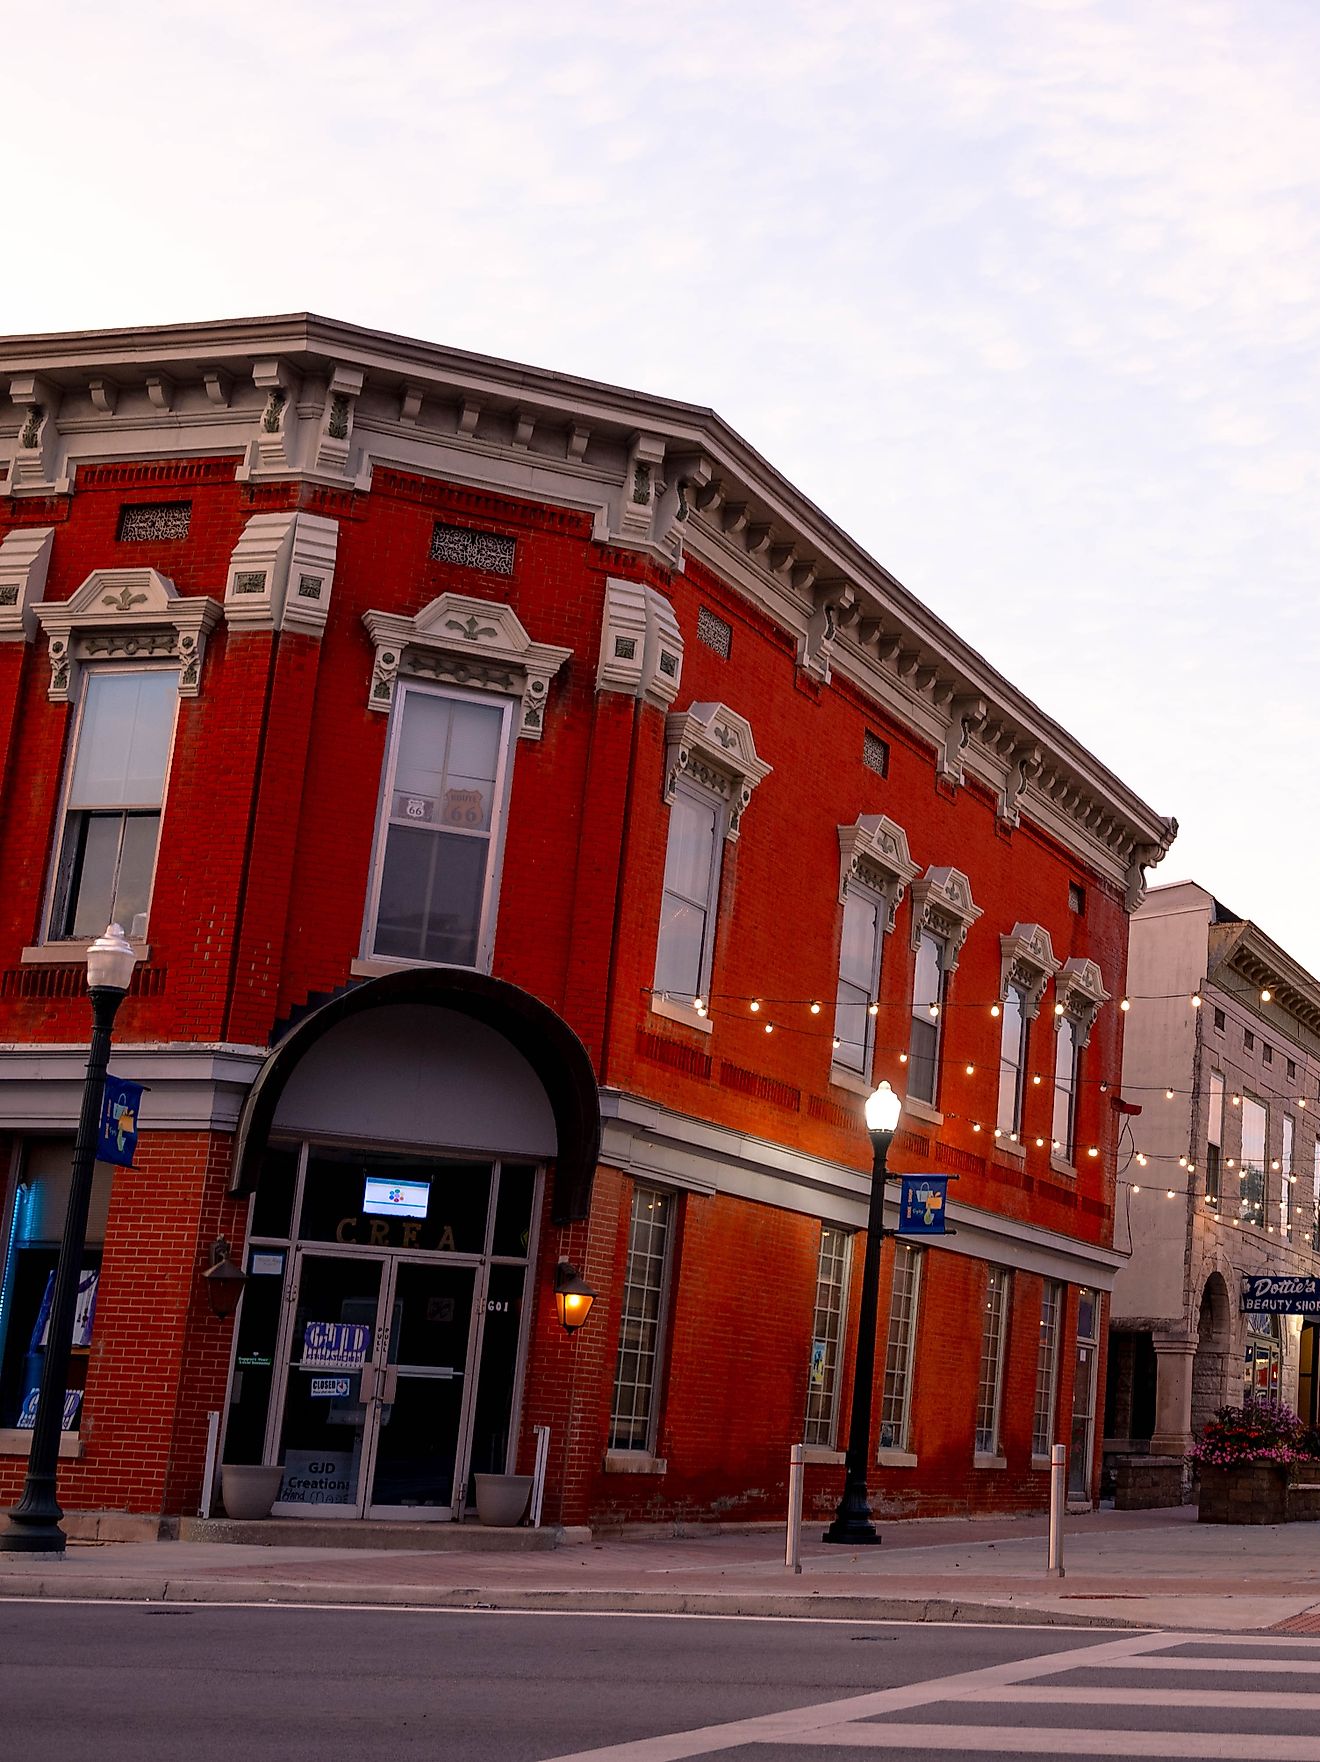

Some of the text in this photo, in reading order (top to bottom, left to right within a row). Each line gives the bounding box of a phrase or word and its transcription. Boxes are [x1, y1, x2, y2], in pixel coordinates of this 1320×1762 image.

[409, 806, 422, 815] 66
[452, 807, 477, 823] 66
[1254, 1278, 1316, 1297] Dottie's
[487, 1299, 509, 1313] 601
[1246, 1299, 1293, 1311] BEAUTY
[304, 1323, 371, 1352] GJD
[312, 1380, 336, 1390] CLOSED
[309, 1462, 336, 1474] GJD
